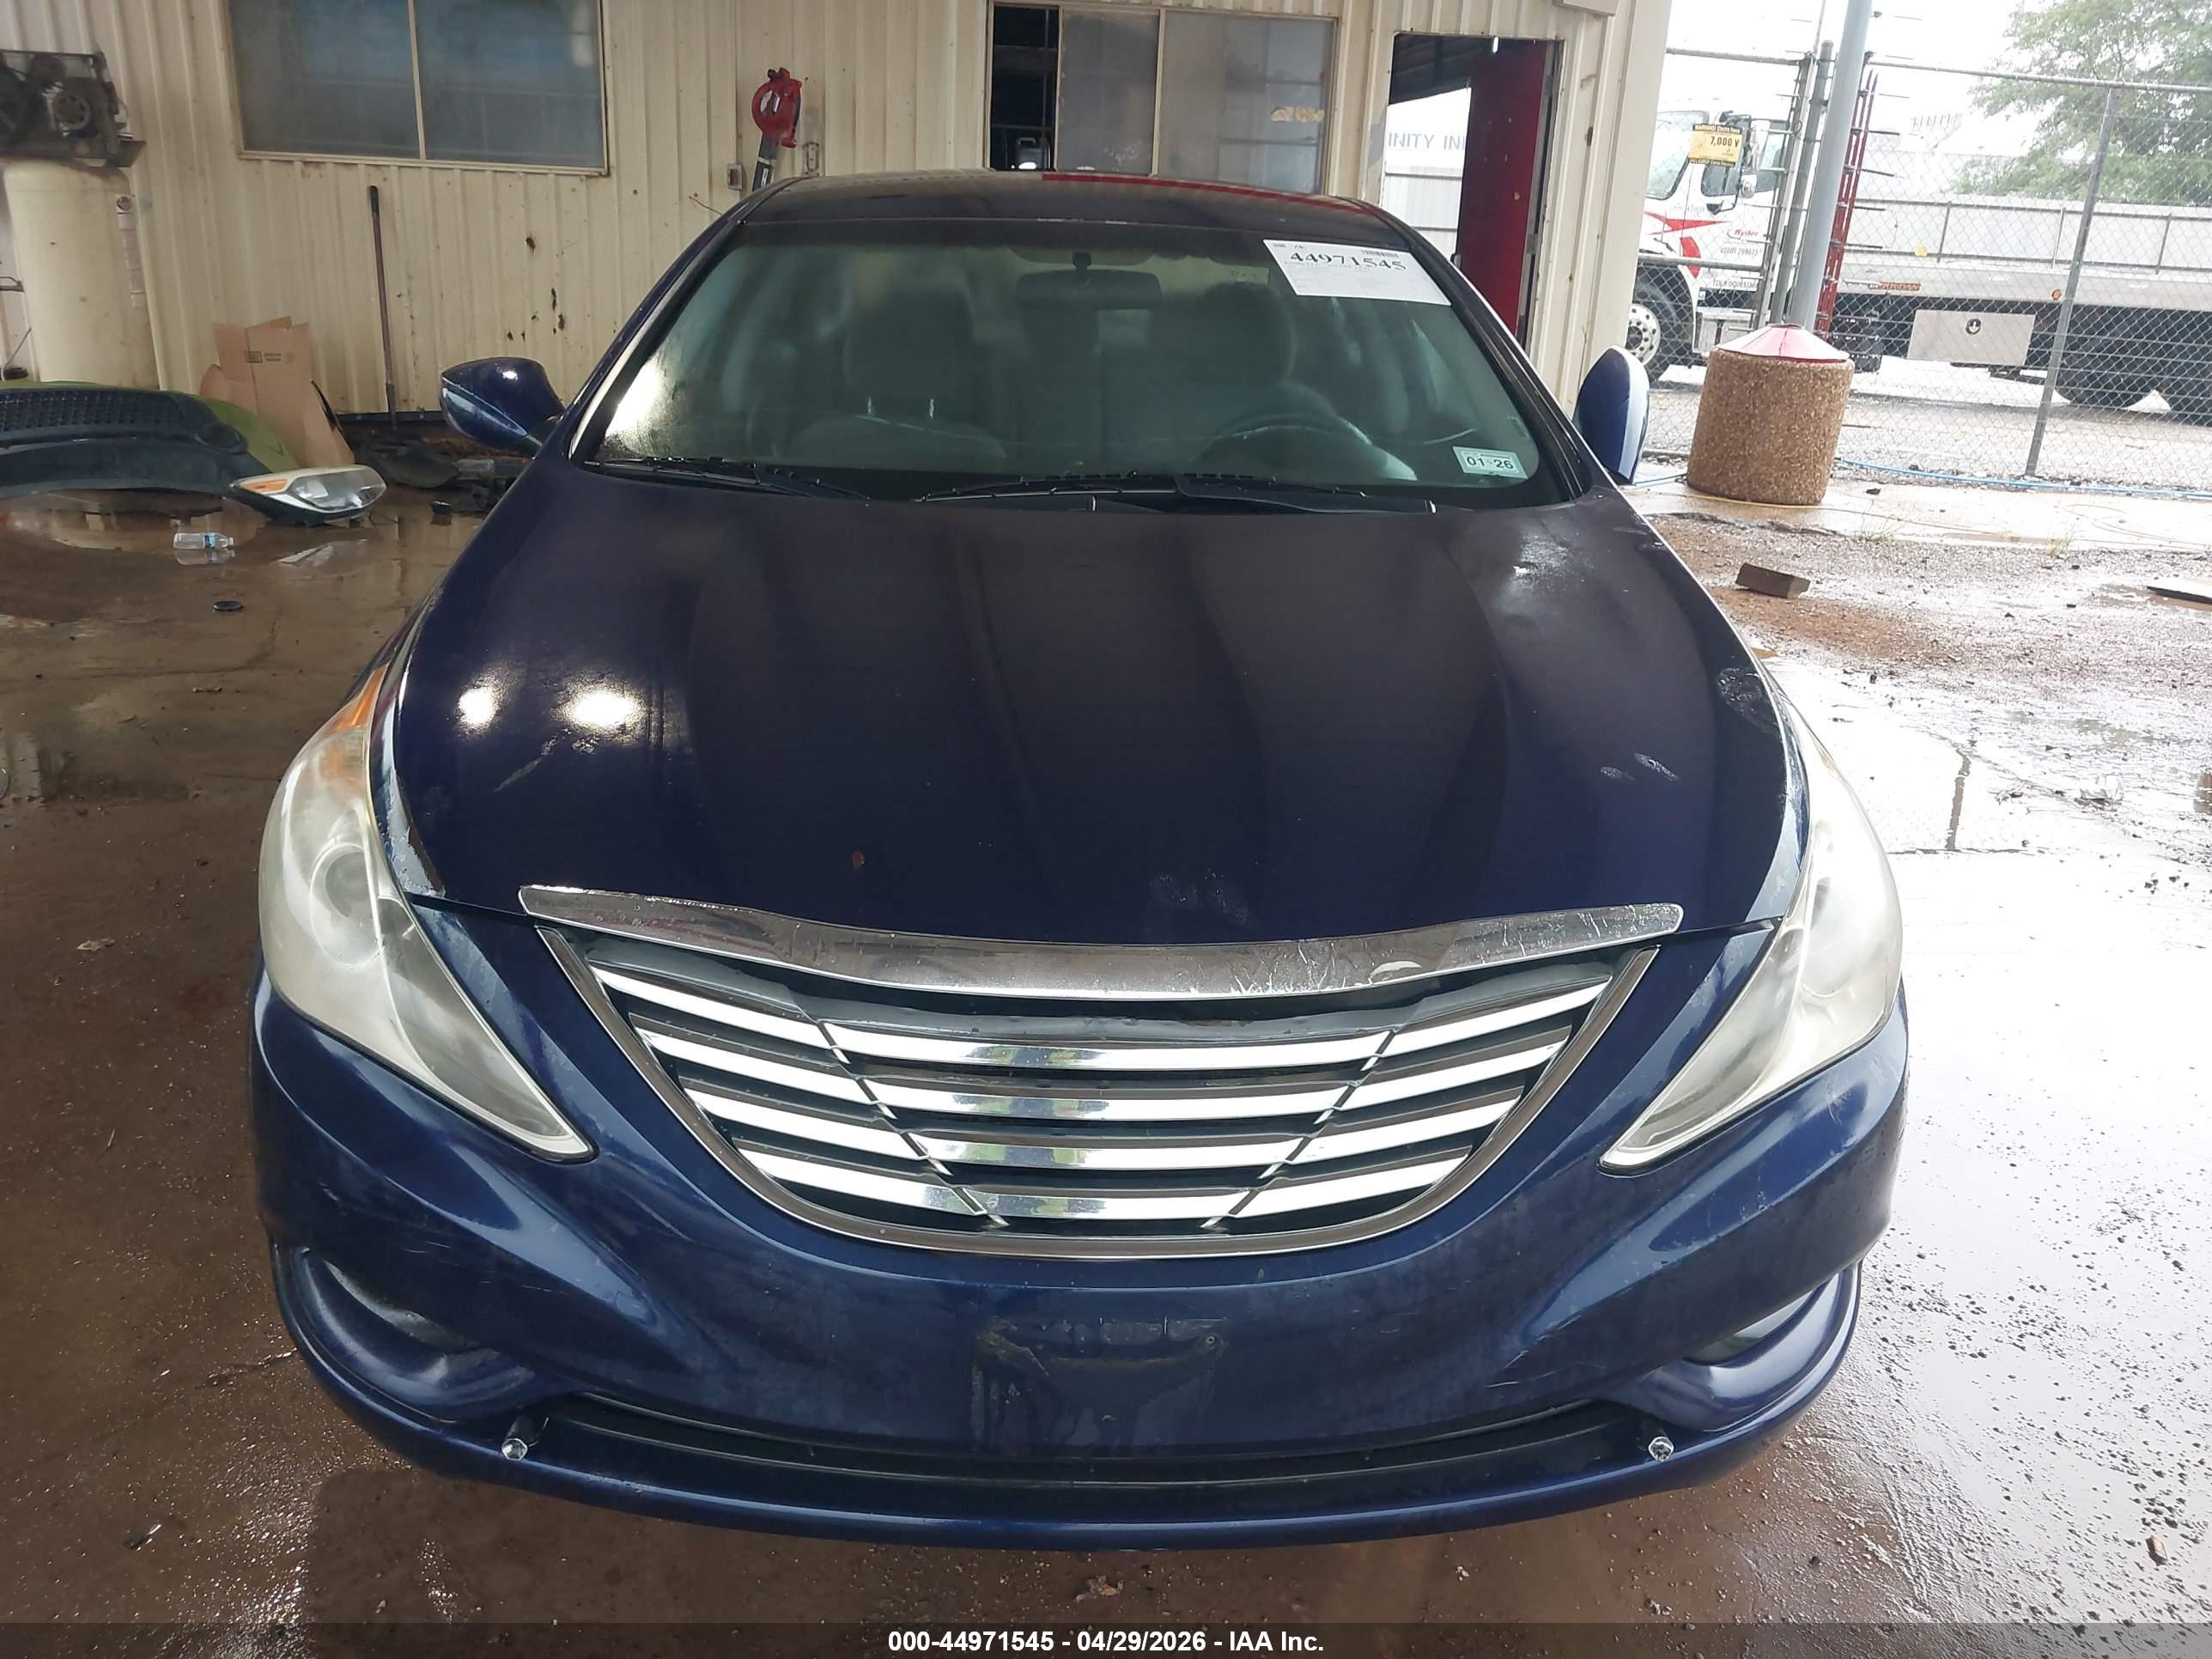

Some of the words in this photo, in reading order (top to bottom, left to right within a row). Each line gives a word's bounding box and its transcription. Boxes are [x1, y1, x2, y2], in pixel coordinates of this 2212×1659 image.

[1388, 131, 1435, 149] INITY
[1710, 136, 1733, 147] 7,000
[1735, 138, 1741, 148] V
[1291, 252, 1407, 271] 44971545
